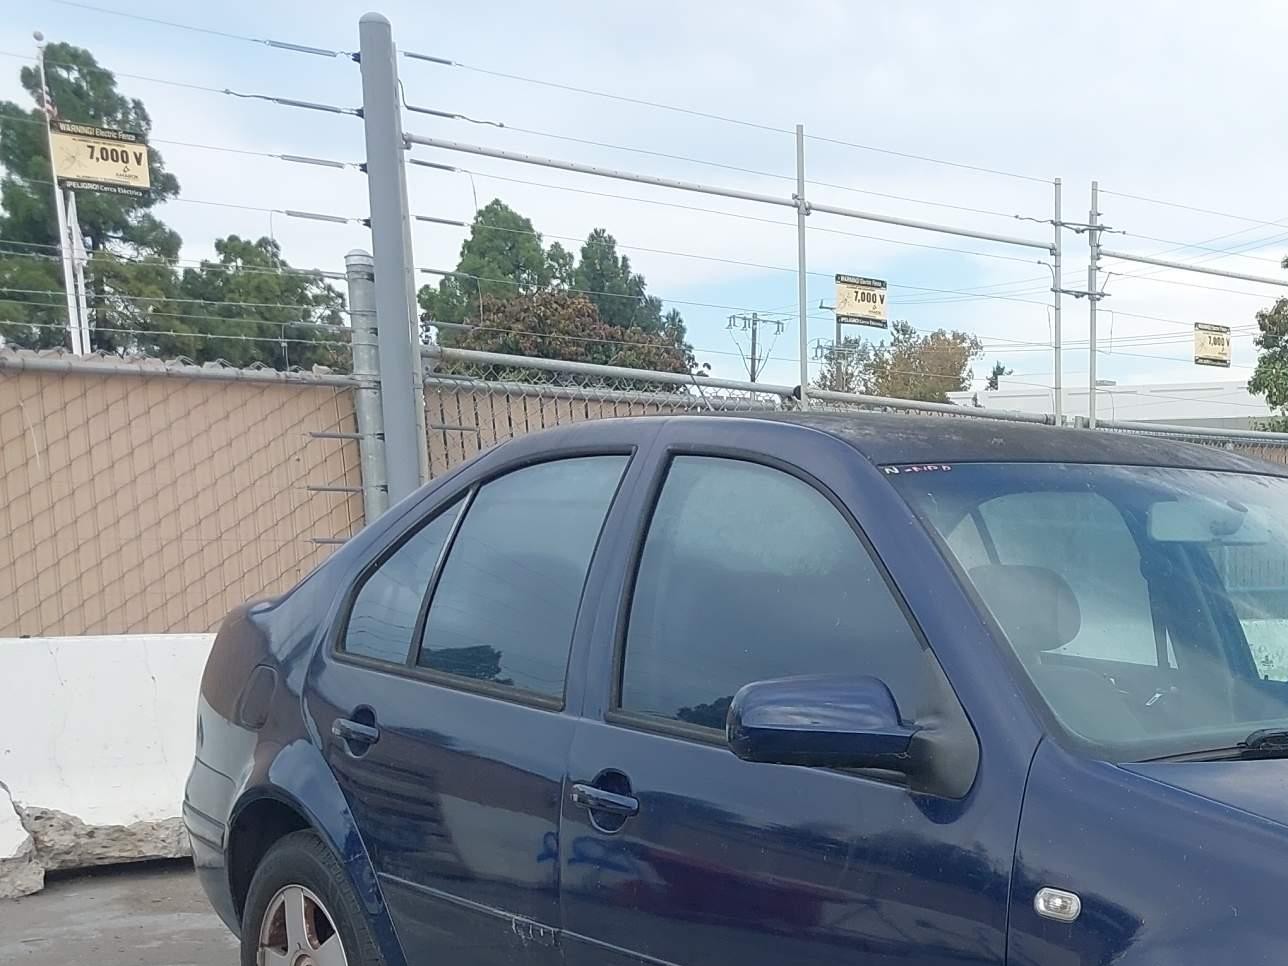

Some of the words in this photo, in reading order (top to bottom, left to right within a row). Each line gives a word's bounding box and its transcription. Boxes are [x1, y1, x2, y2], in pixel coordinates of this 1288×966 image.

[58, 121, 95, 137] WARNING!
[95, 128, 117, 139] Electric
[118, 131, 136, 141] Fence
[86, 144, 130, 164] 7,000
[133, 151, 143, 166] V
[854, 290, 877, 304] 7,000
[879, 294, 885, 305] V
